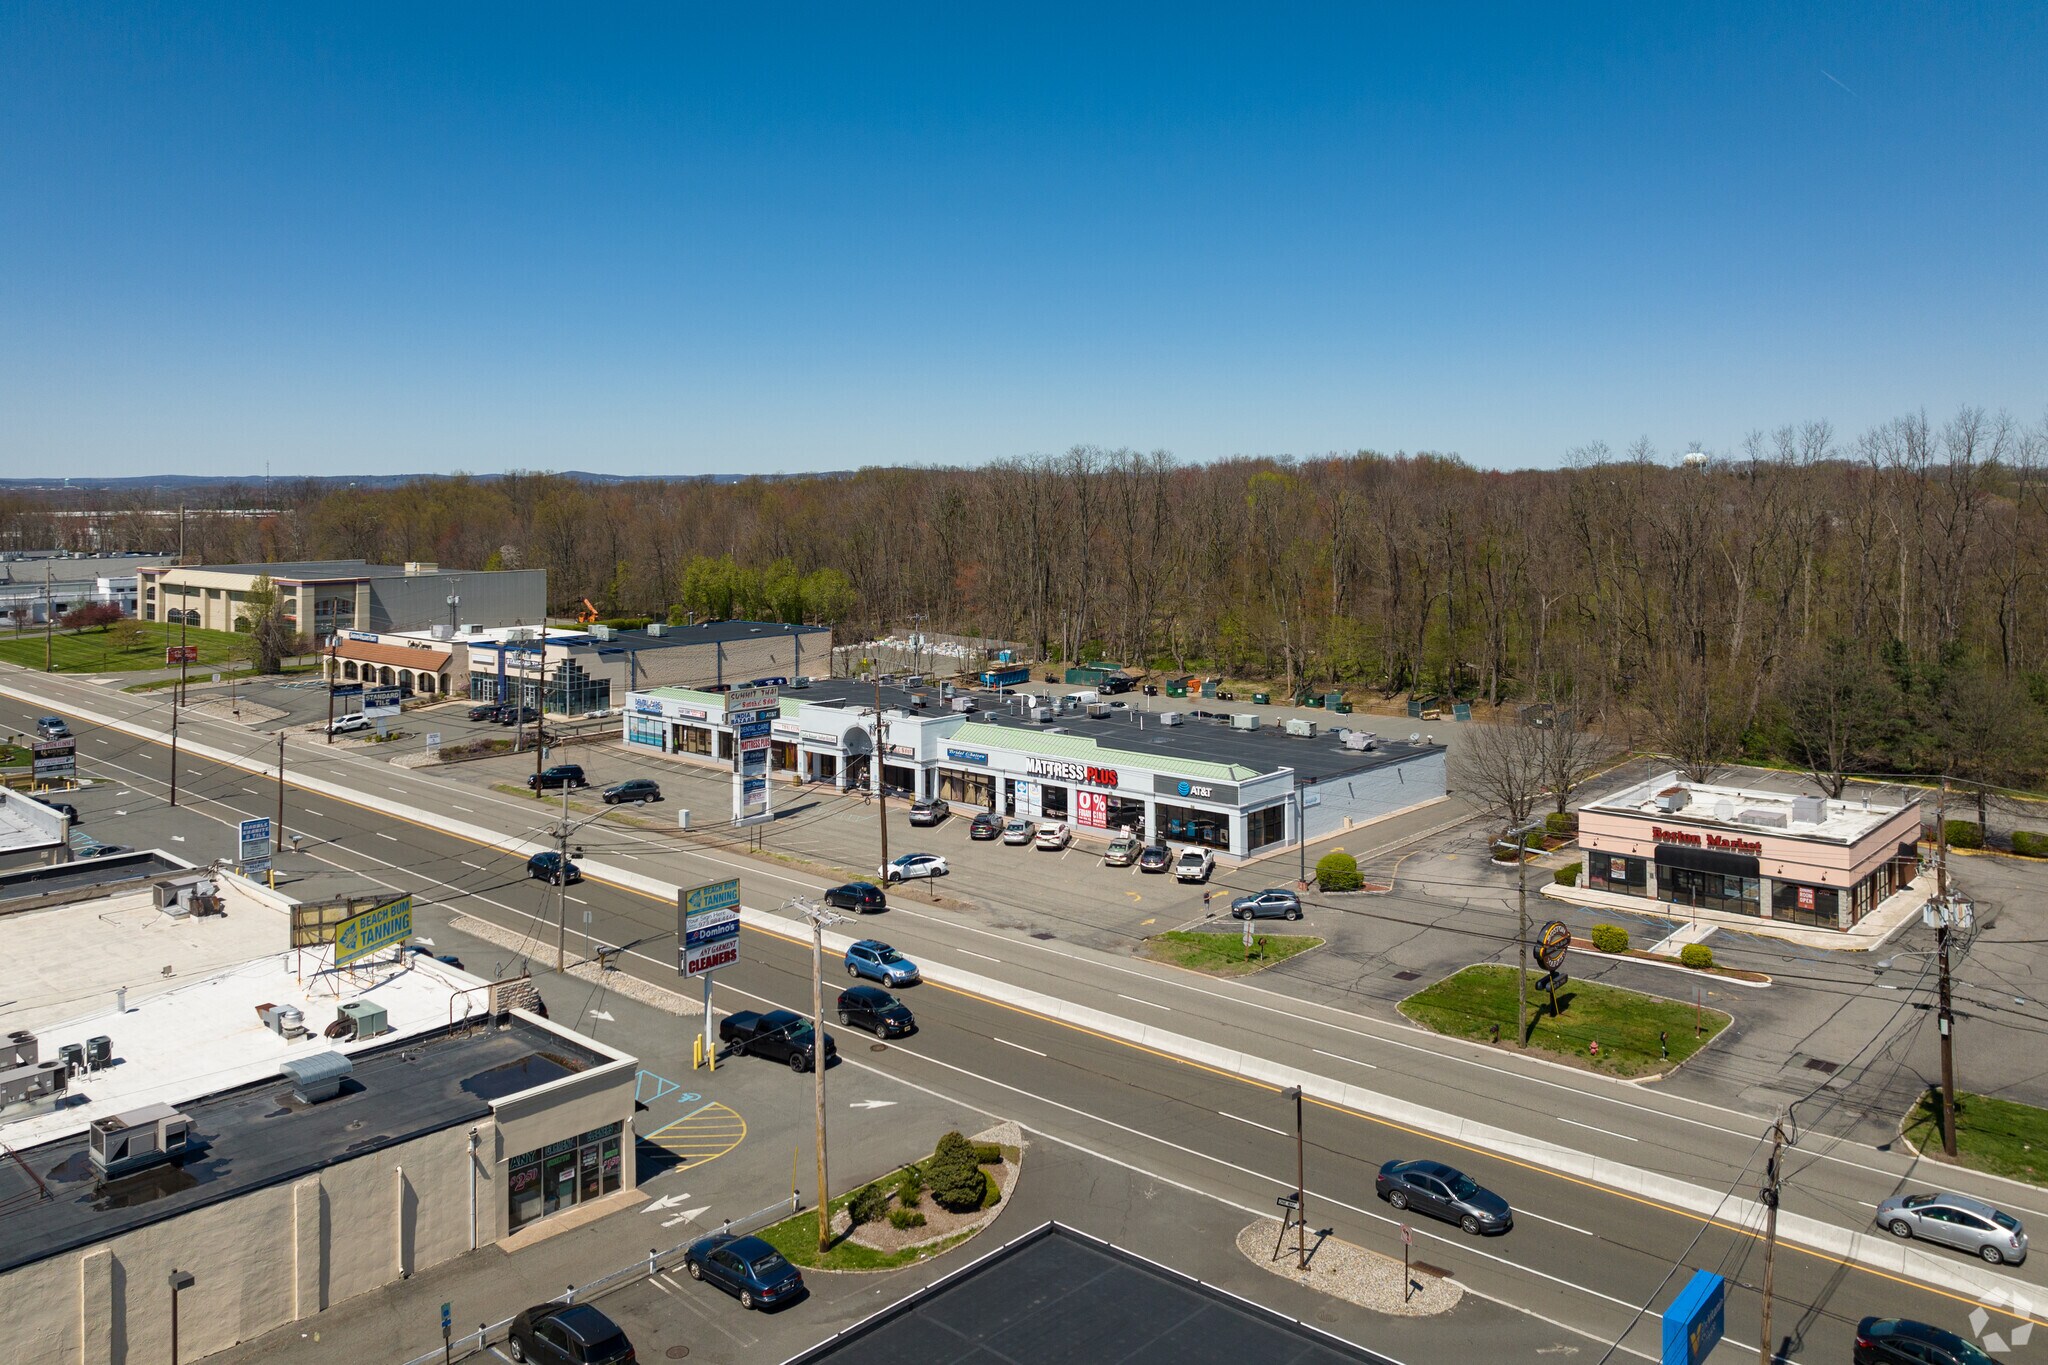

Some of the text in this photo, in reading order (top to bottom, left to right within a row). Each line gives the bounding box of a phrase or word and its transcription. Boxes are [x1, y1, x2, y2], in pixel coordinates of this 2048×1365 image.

[365, 692, 399, 701] STANDARD
[731, 688, 777, 700] SUMMIT THAI
[731, 717, 755, 725] BAZAAR
[740, 724, 756, 733] DENTAL
[757, 722, 769, 730] CARE
[741, 737, 771, 750] MATTRESS PLUS
[1026, 757, 1118, 786] MATTRESS PLUS
[1190, 785, 1212, 798] AT&T
[1652, 826, 1762, 852] Boston Market
[704, 880, 737, 896] BEACH BUM
[704, 890, 737, 906] TANNING
[360, 900, 410, 929] BEACH BUM
[360, 914, 410, 946] TANNING
[699, 924, 735, 939] Domino's
[700, 940, 737, 957] ANY GARMENT
[688, 949, 737, 974] CLEANERS
[510, 1150, 536, 1169] ANY
